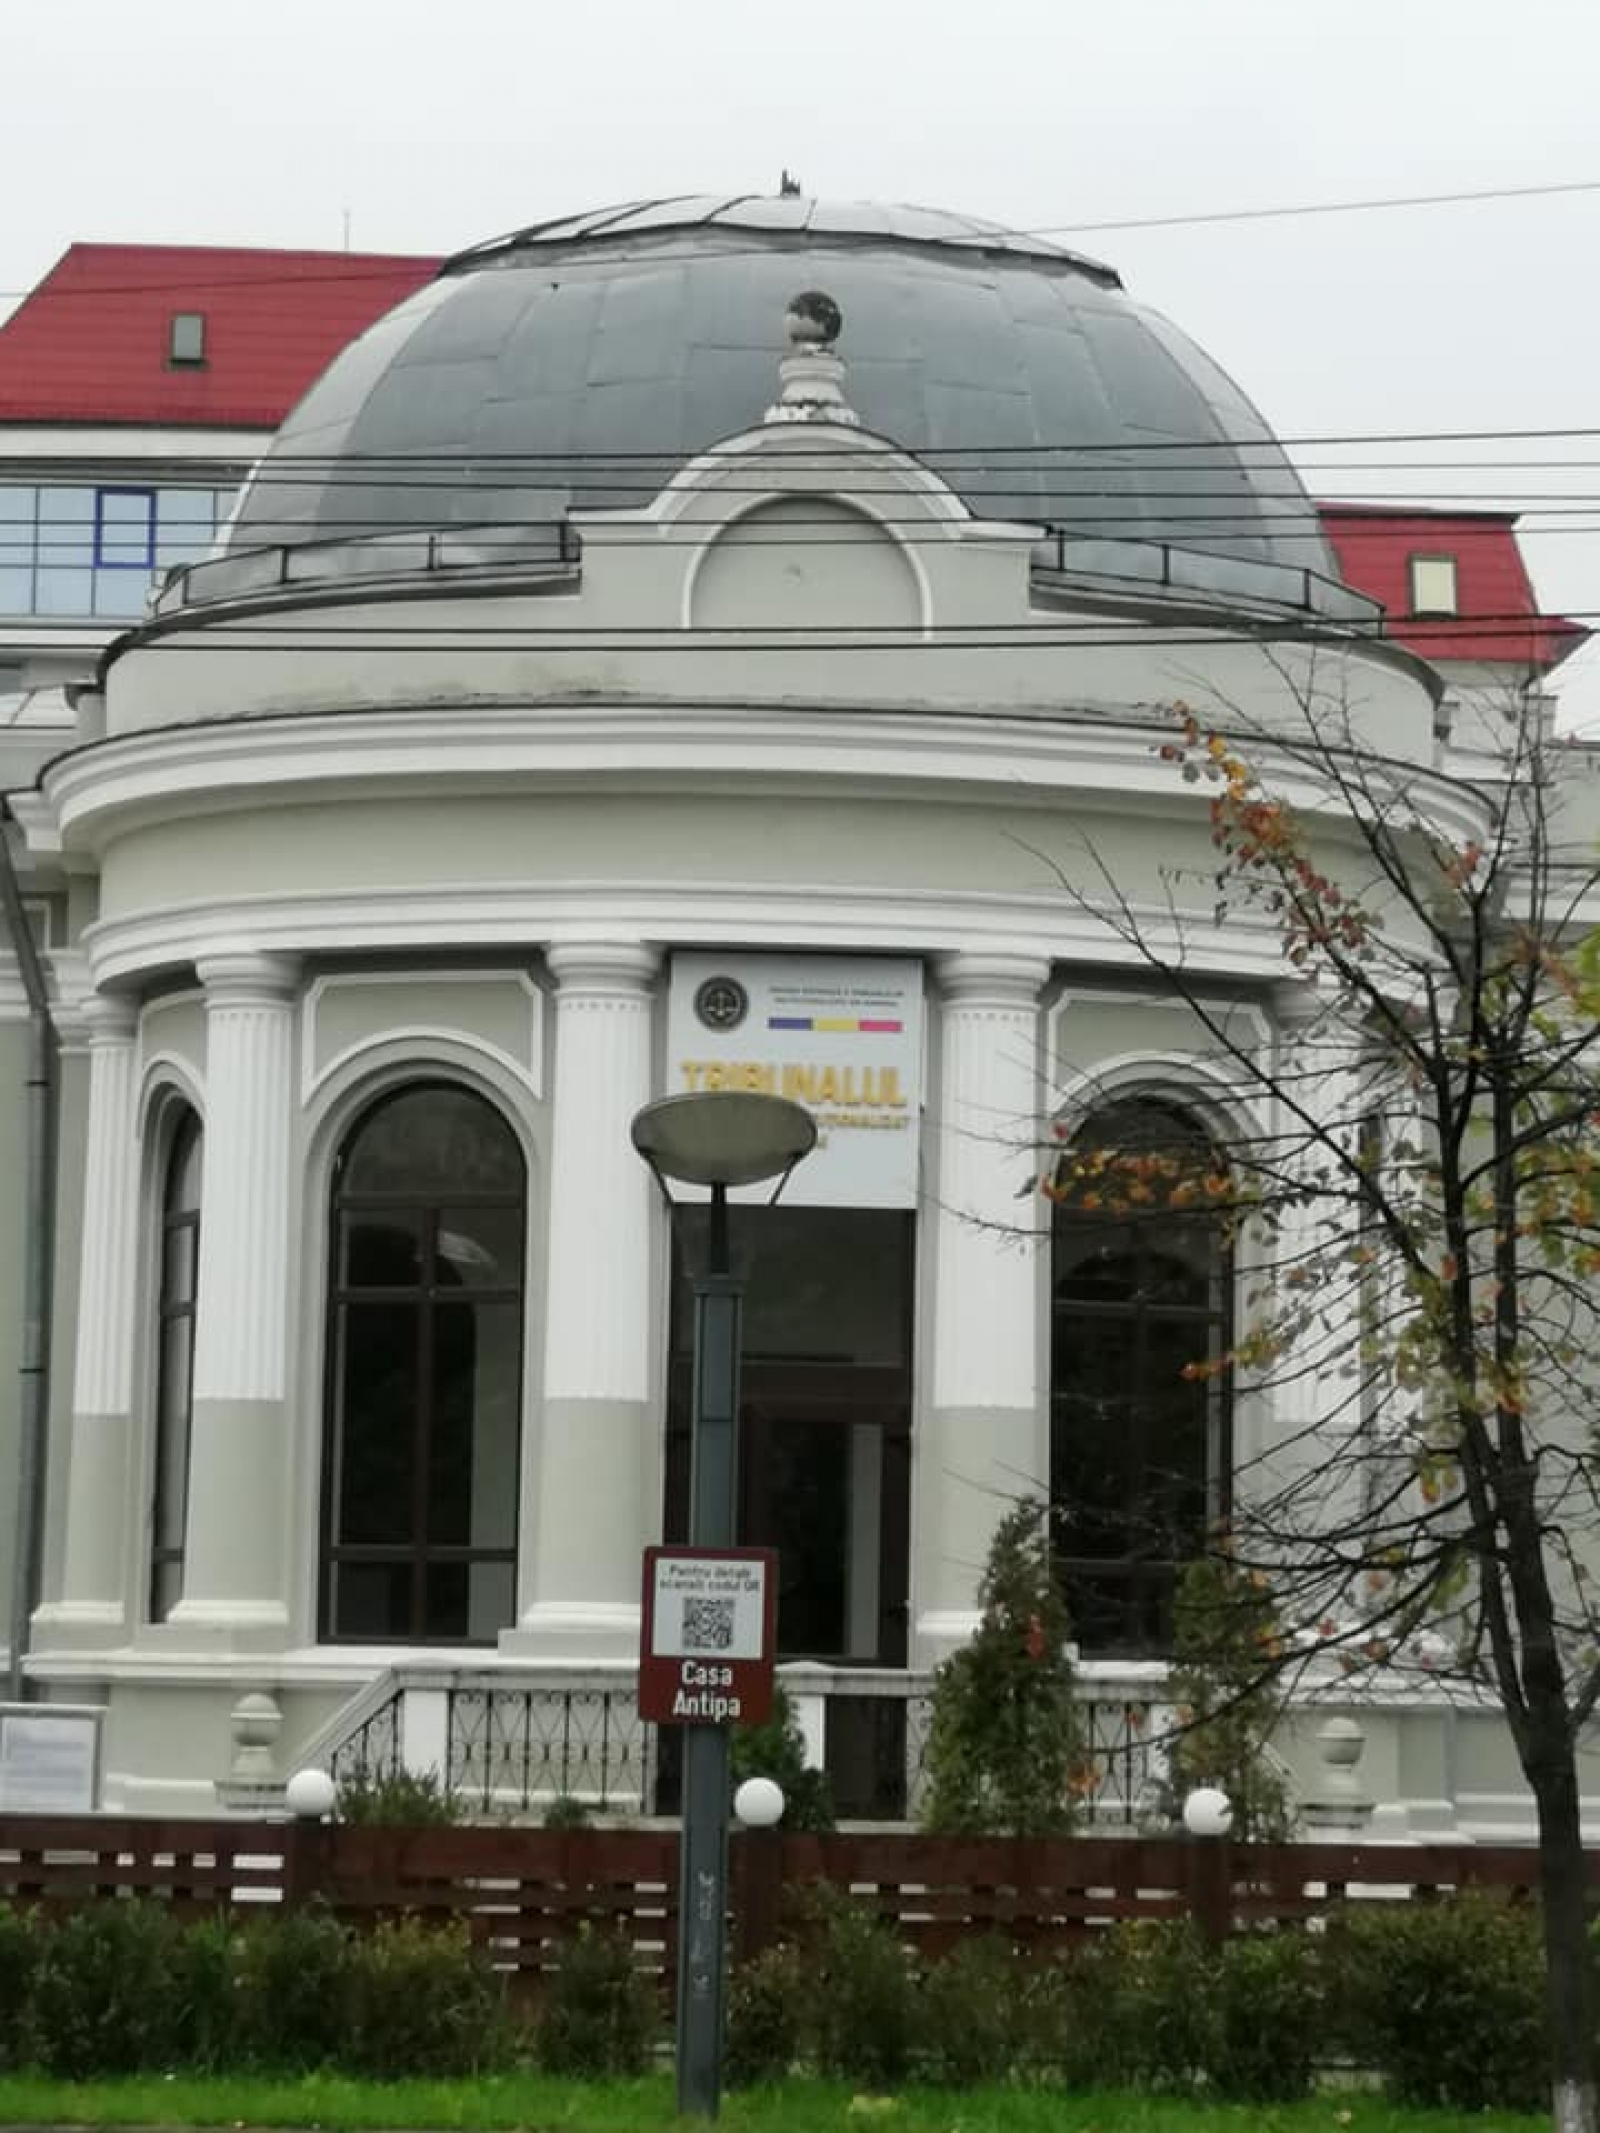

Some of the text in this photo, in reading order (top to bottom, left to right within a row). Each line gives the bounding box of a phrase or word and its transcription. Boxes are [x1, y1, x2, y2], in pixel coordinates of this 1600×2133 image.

[681, 1060, 908, 1107] TRIBUNALUL
[681, 1659, 733, 1686] Casa
[672, 1688, 741, 1723] Antipa
